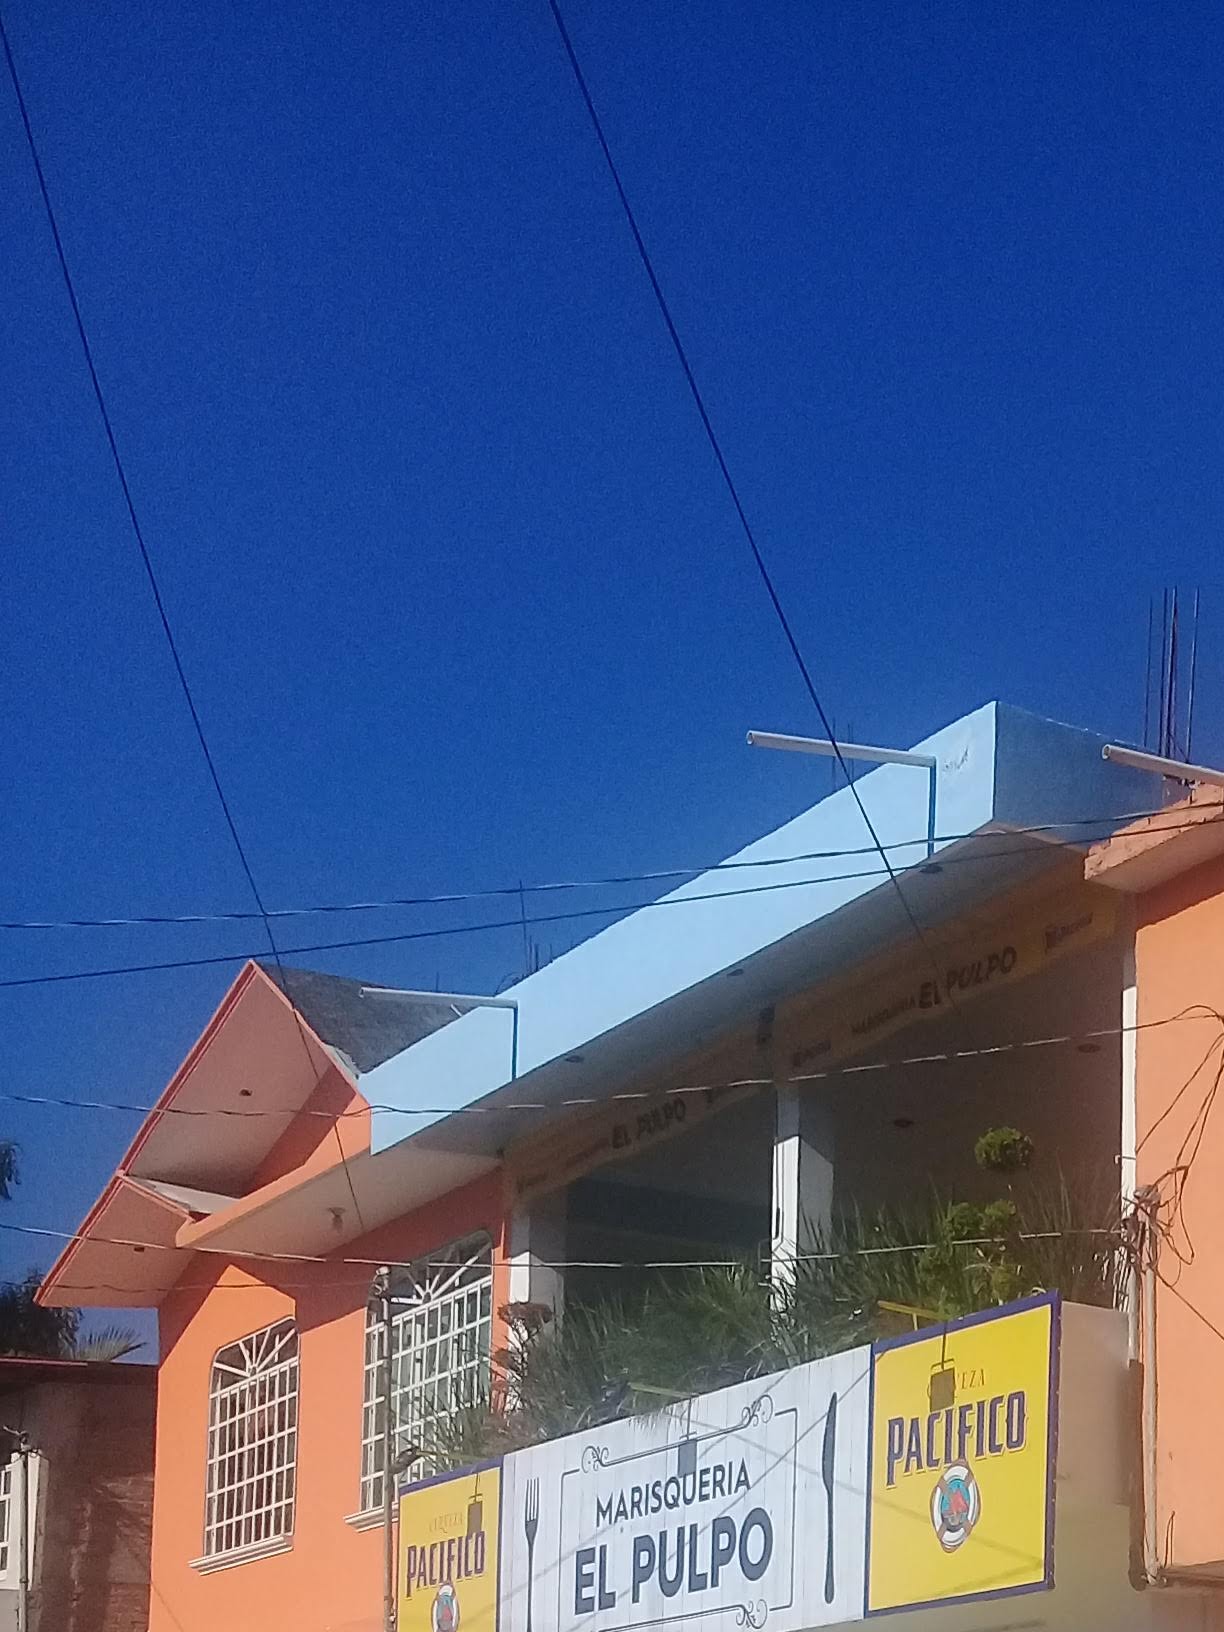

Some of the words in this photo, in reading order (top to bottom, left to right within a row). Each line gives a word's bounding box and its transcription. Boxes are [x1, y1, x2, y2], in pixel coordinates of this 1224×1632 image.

[946, 945, 1017, 993] PULPO
[885, 1390, 1028, 1490] PACIFICO
[596, 1456, 751, 1528] MARISQUERIA
[406, 1531, 486, 1600] PACIFICO
[575, 1544, 617, 1616] EL
[632, 1506, 774, 1604] PULPO
